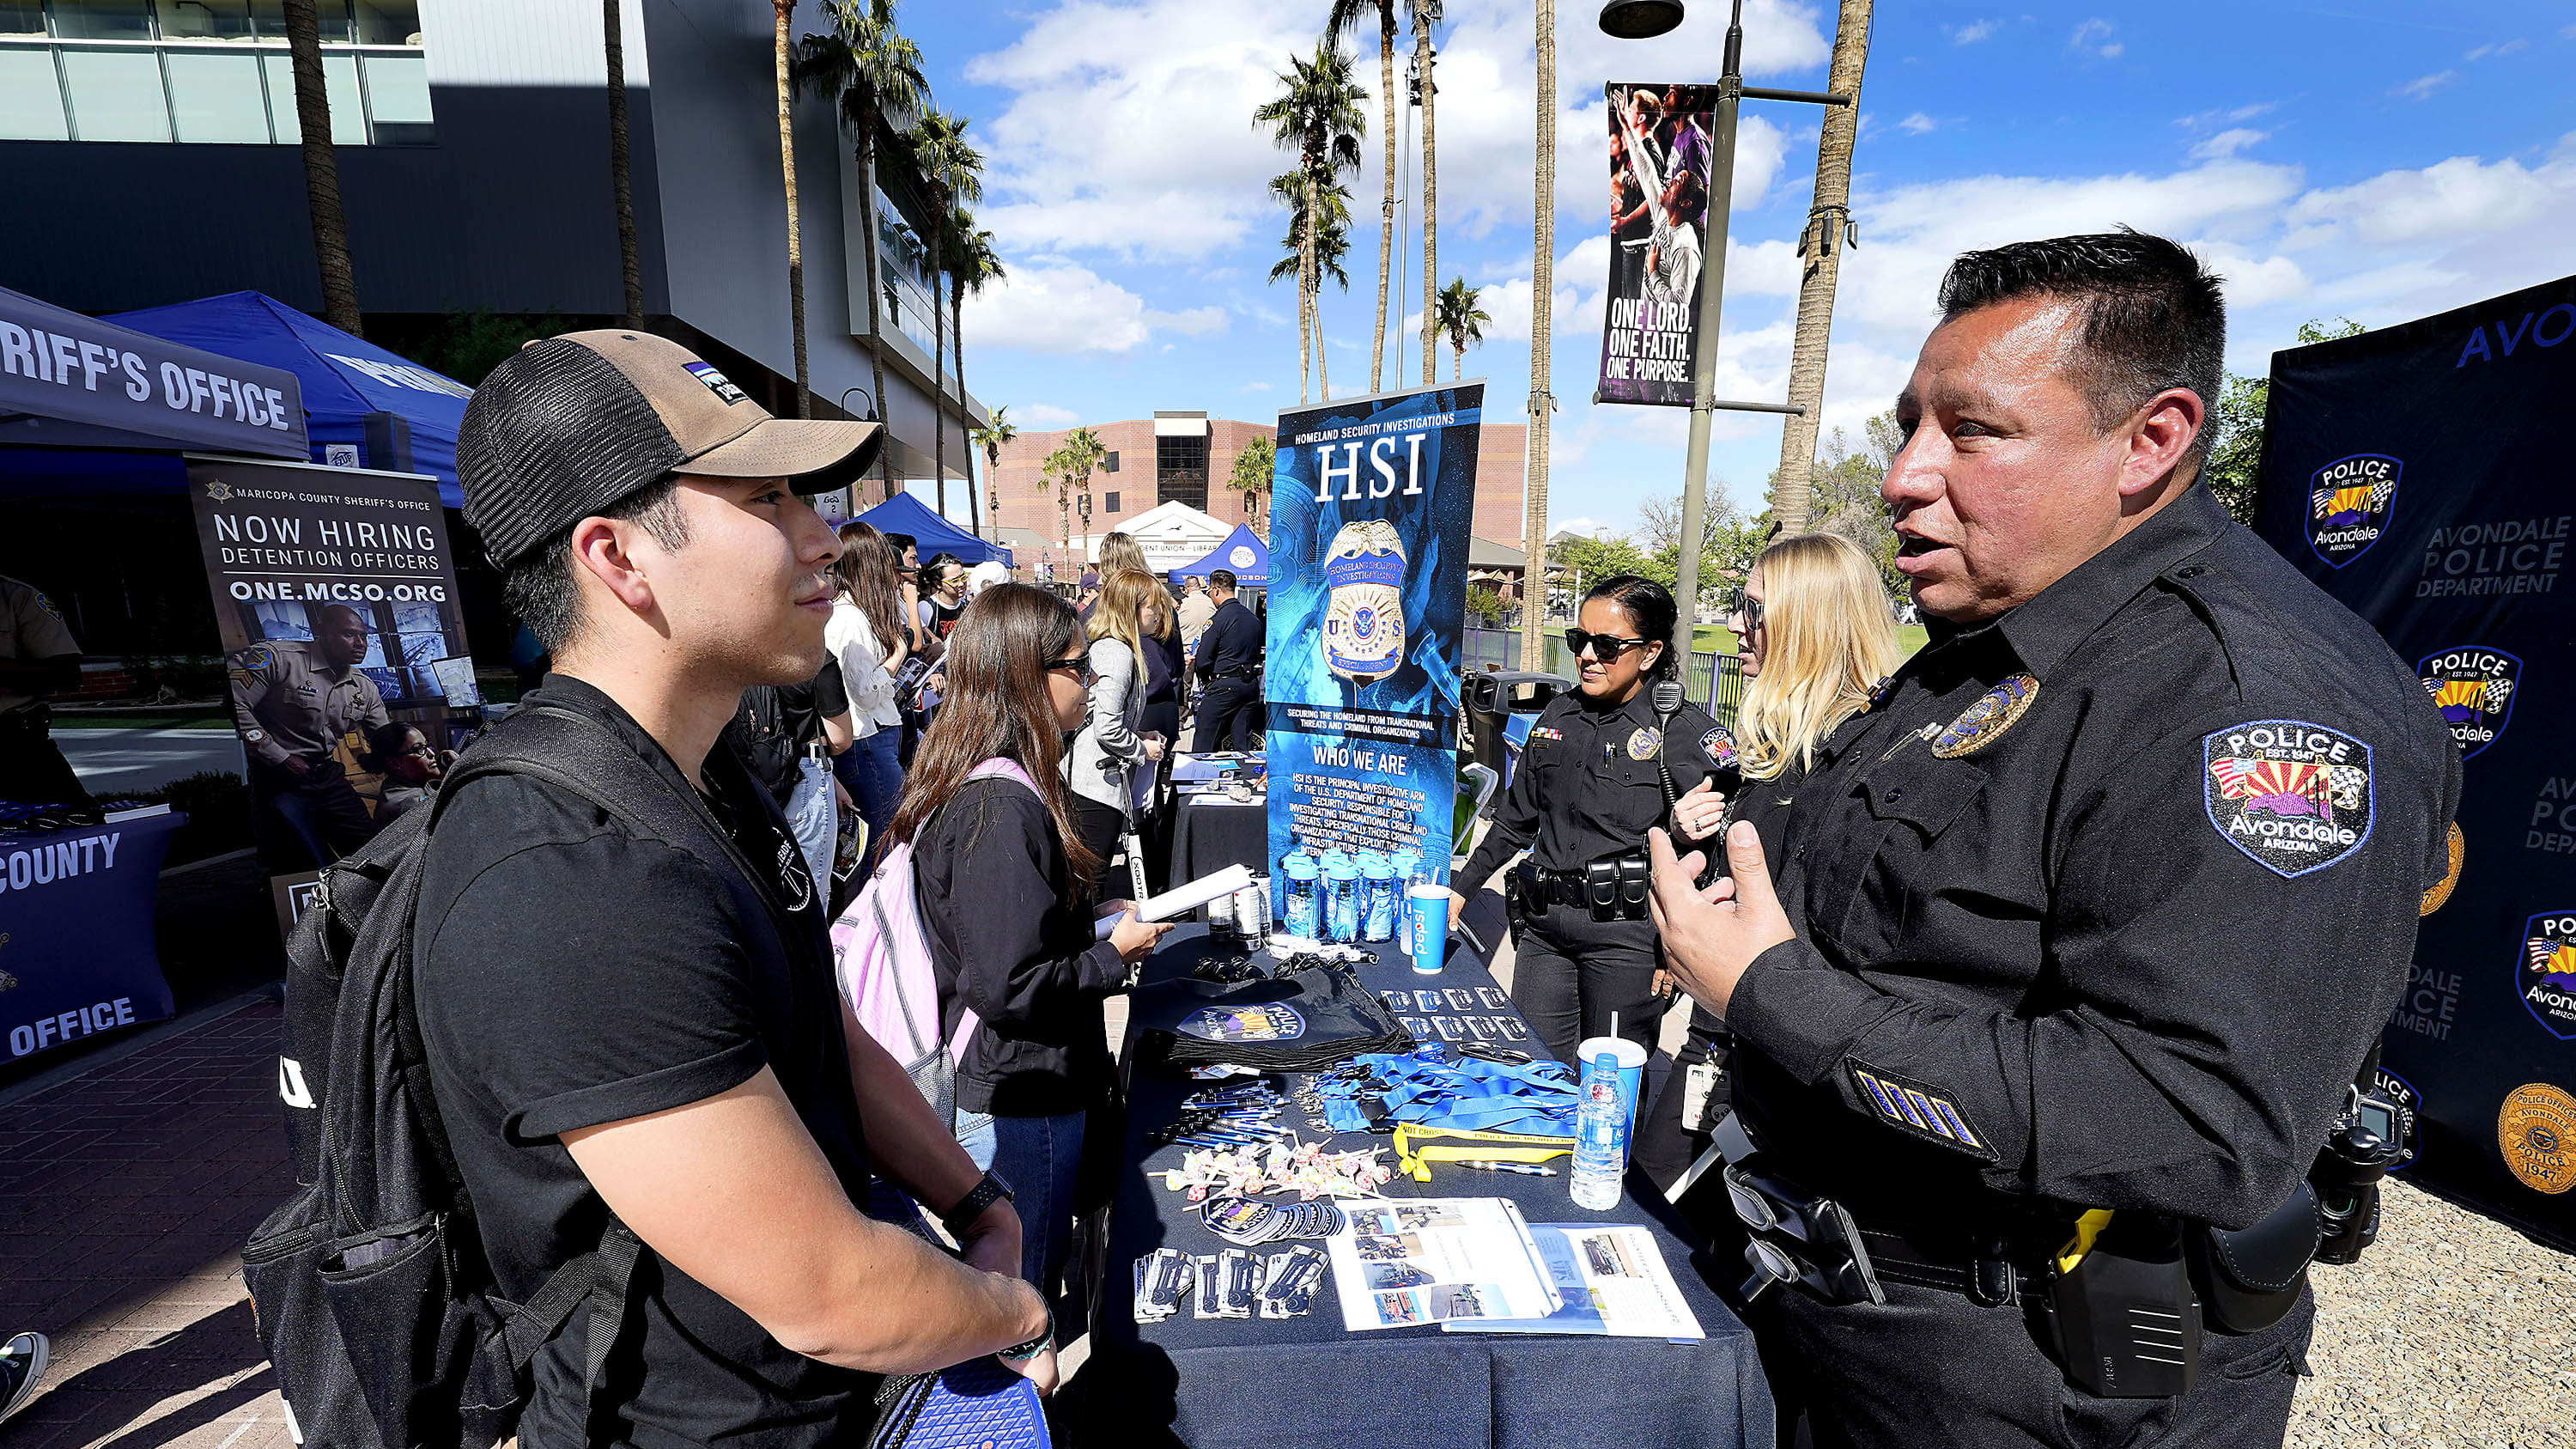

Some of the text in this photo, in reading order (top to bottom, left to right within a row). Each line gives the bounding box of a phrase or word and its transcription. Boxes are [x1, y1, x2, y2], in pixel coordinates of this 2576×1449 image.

[1611, 297, 1692, 332] ONE LORD.
[1608, 328, 1690, 360] ONE FAITH.
[0, 320, 151, 402] RIFF'S
[160, 362, 289, 431] OFFICE
[1606, 356, 1689, 382] ONE PURPOSE.
[1295, 413, 1455, 445] HOMELAND SECURITY INVESTIGATIONS
[1315, 433, 1426, 502] HSI
[2322, 460, 2391, 486] POLICE
[236, 488, 430, 511] MARICOPA COUNTY SHERIFF'S OFFICE
[214, 514, 435, 551] NOW HIRING
[2314, 526, 2379, 545] Avondale
[2427, 515, 2571, 550] AVONDALE
[221, 547, 439, 570] DETENTION OFFICERS
[1329, 561, 1368, 575] HOMELAND
[2421, 541, 2566, 577] POLICE
[229, 581, 446, 602] ONE.MCSO.ORG
[2415, 573, 2558, 599] DEPARTMENT
[1328, 618, 1401, 636] U S
[2432, 652, 2508, 677] POLICE
[1287, 708, 1435, 730] SECURING THE HOMELAND FROM TRANSNATIONAL
[1300, 719, 1420, 739] THREATS AND CRIMINAL ORGANIZATIONS
[2227, 727, 2351, 764] POLICE
[1313, 746, 1407, 776] WHO WE ARE
[1292, 773, 1425, 801] HSI IS THE PRINCIPAL INVESTIGATIVE ARM
[1293, 783, 1424, 813] OF THE U.S. DEPARTMENT OF HOMELAND
[1289, 802, 1428, 837] INVESTIGATING TRANSNATIONAL CRIME AND
[1311, 796, 1405, 820] SECURITY, RESPONSIBLE FOR
[1290, 823, 1342, 840] ORGANIZATIONS
[1344, 832, 1358, 843] THAT
[1358, 835, 1386, 849] EXPLOIT
[1386, 841, 1398, 852] THE
[1293, 813, 1422, 847] THREATS, SPECIFICALLY THOSE CRIMINAL
[2228, 814, 2356, 845] Avondale
[1302, 836, 1358, 853] INFRASTRUCTURE
[2263, 837, 2318, 853] ARIZONA
[1413, 909, 1429, 955] pepsi
[2409, 964, 2463, 995] DALE
[10, 997, 135, 1057] OFFICE
[1267, 1006, 1298, 1035] POLICE
[2374, 1072, 2411, 1104] LICE
[2518, 1095, 2546, 1105] POLICE
[2521, 1109, 2572, 1130] AVONDALE
[2516, 1142, 2566, 1166] POLICE
[2525, 1162, 2557, 1182] 1947
